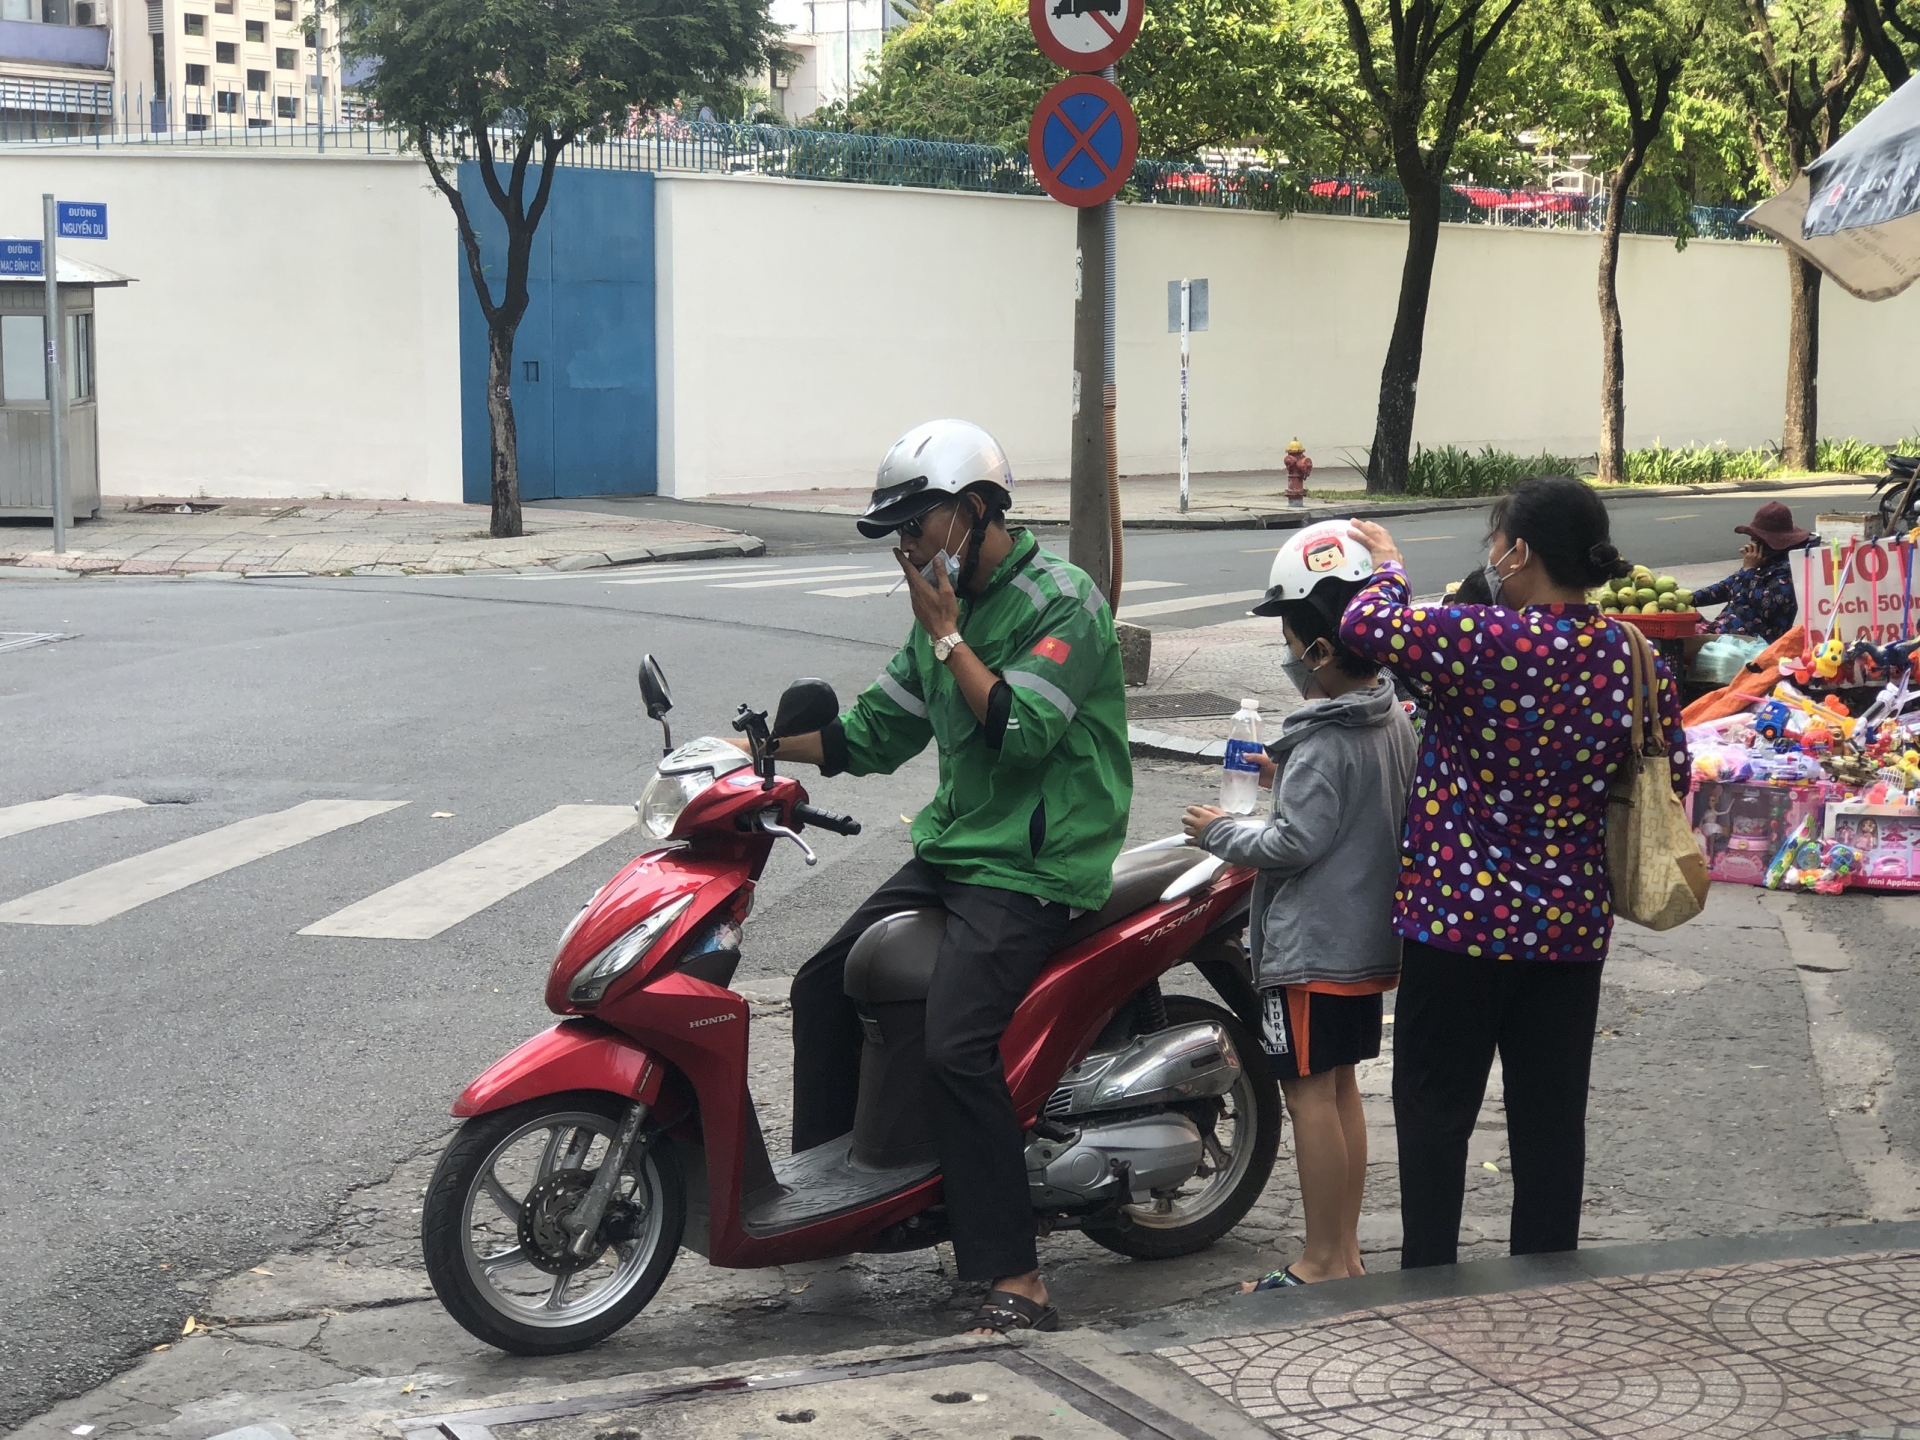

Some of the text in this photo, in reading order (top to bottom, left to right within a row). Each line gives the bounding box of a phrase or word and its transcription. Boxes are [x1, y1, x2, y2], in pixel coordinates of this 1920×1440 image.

[68, 206, 98, 218] ĐƯỜNG
[93, 223, 104, 235] DU
[7, 243, 33, 255] ĐƯỜNG
[30, 260, 41, 272] CHI
[1867, 877, 1885, 886] Mini
[1139, 899, 1213, 946] VISION
[689, 1013, 738, 1029] HONDA
[1271, 1000, 1283, 1042] YORK
